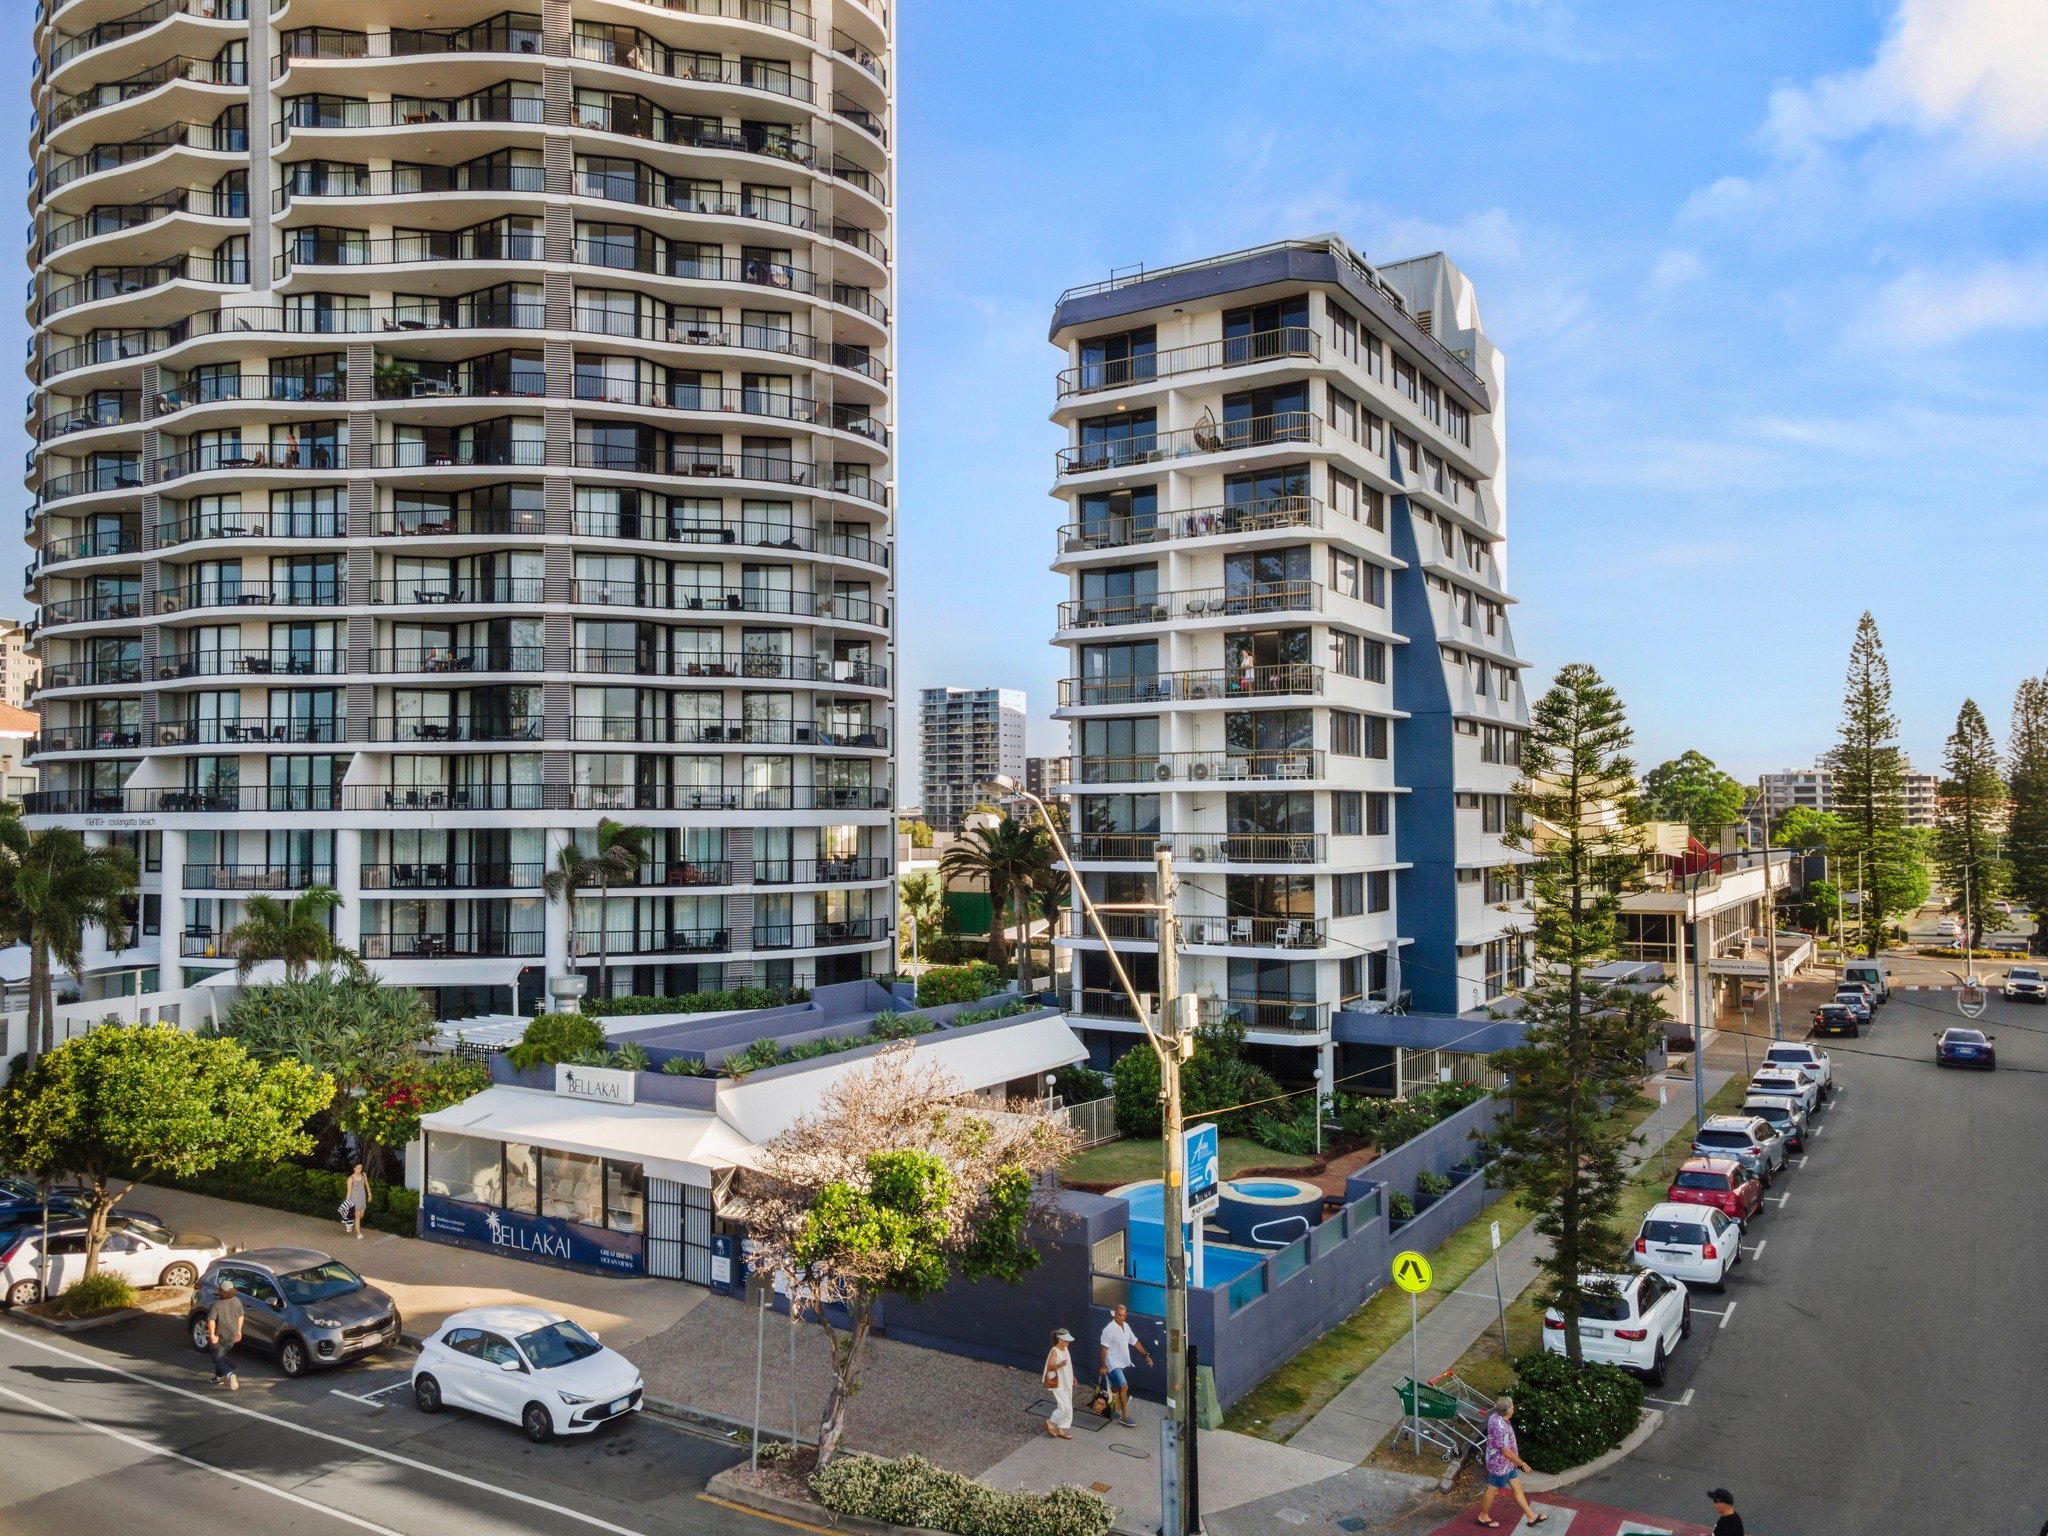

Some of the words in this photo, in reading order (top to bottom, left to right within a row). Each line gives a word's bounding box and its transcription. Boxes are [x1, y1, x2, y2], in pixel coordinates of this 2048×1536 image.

[108, 817, 137, 828] coolangatta
[139, 817, 156, 827] beach
[568, 1079, 620, 1099] BELLAKAI
[491, 1225, 571, 1259] BELLAKAI
